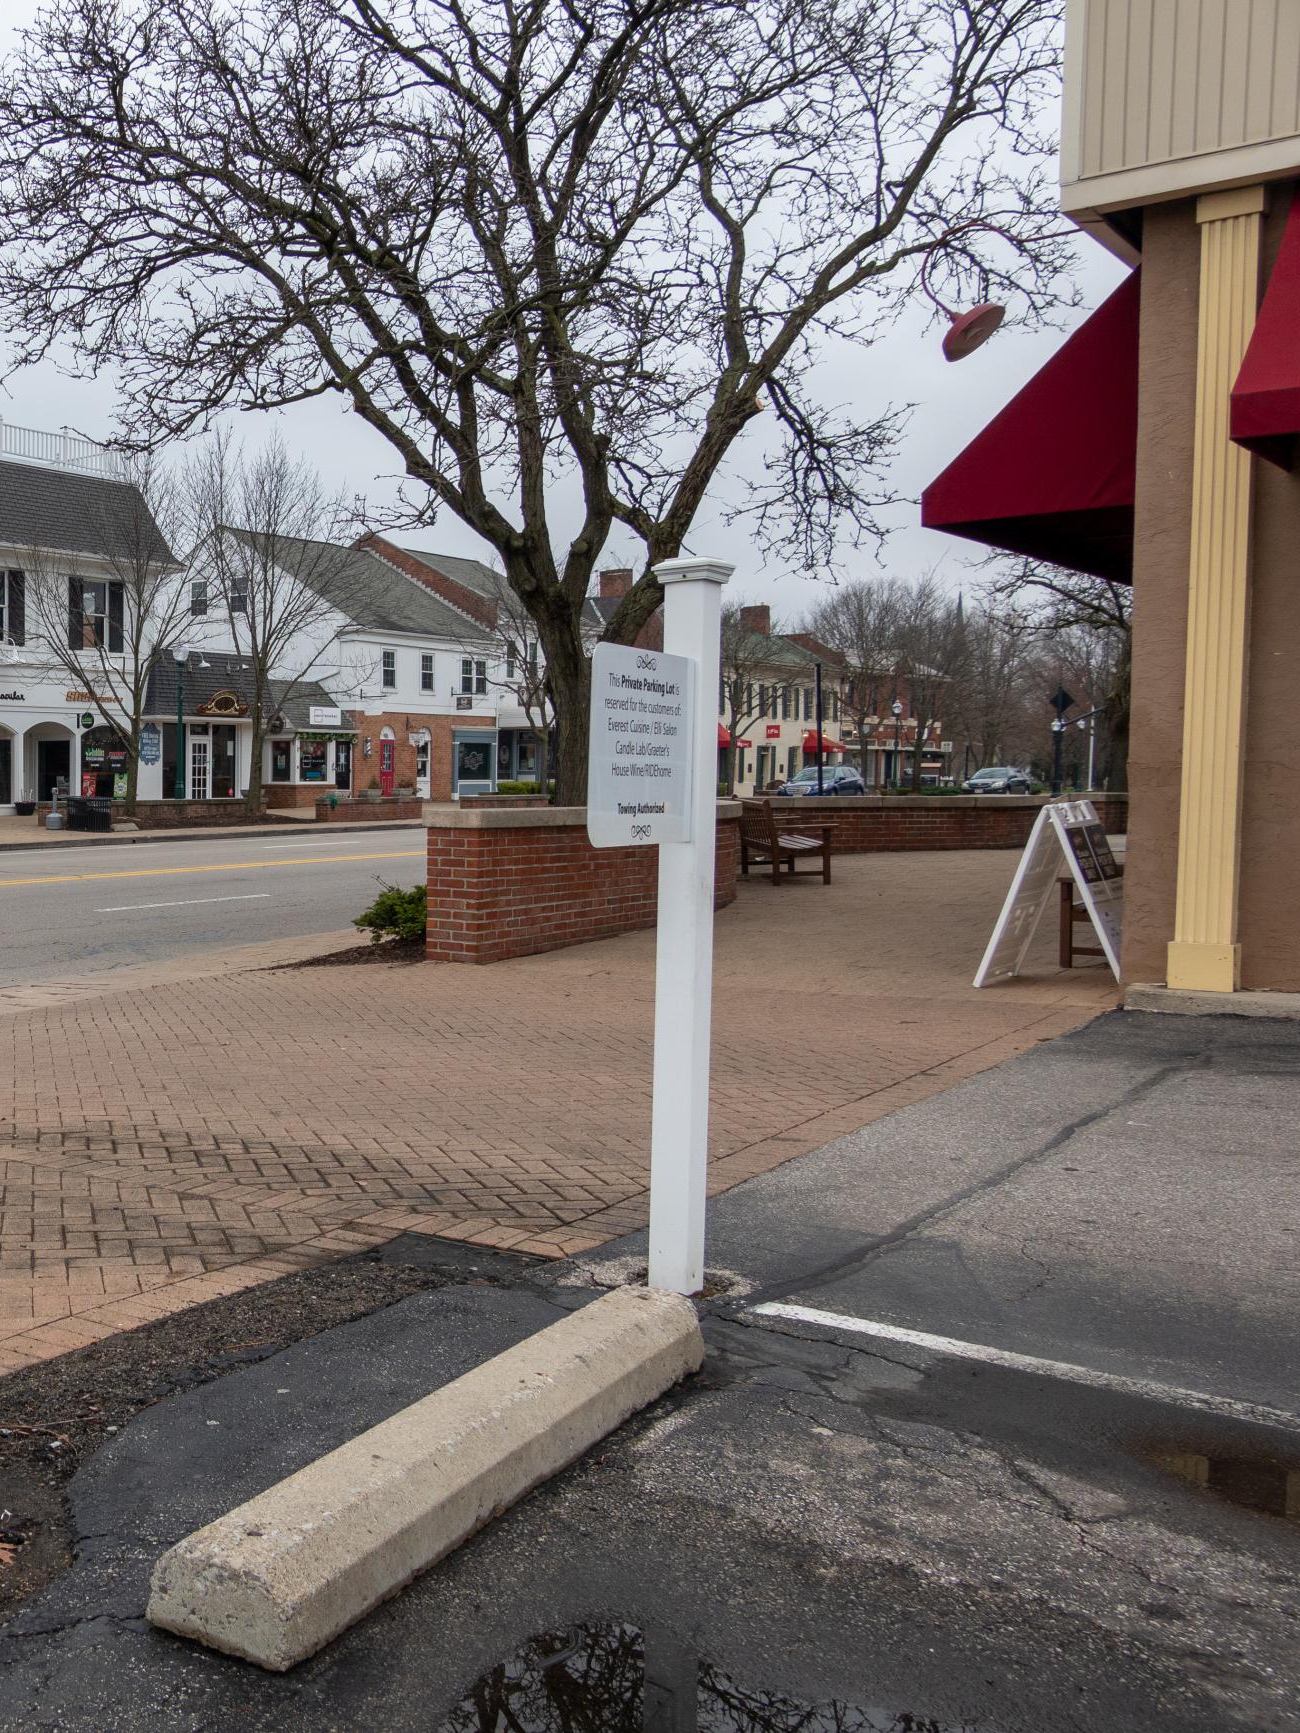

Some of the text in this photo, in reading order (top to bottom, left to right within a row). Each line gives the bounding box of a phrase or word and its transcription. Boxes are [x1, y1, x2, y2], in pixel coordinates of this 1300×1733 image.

[609, 672, 680, 697] This Private Parking Lot is
[604, 697, 629, 711] reserved
[629, 697, 637, 712] for
[638, 698, 648, 713] the
[647, 702, 674, 716] customers
[608, 717, 629, 733] Everest
[629, 719, 650, 735] Cuisine
[662, 722, 678, 737] Salon
[615, 740, 635, 755] Candle
[611, 762, 630, 777] House
[617, 801, 665, 818] Towing Authorized
